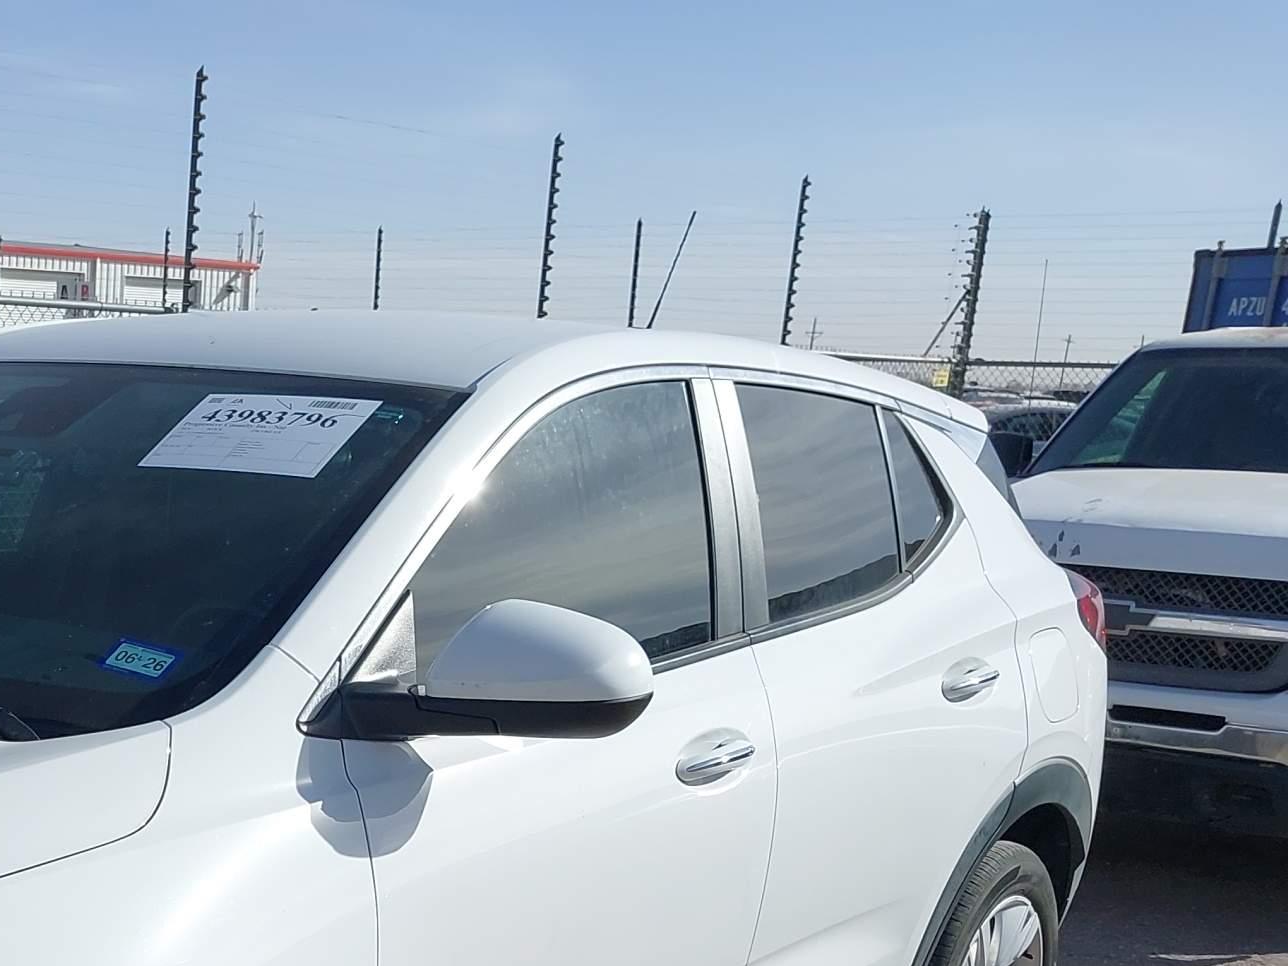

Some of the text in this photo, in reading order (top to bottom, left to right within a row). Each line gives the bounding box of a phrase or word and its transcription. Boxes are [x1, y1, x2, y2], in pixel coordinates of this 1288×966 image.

[1228, 296, 1267, 316] APZU
[201, 408, 338, 429] 43983796
[142, 658, 166, 671] 26
